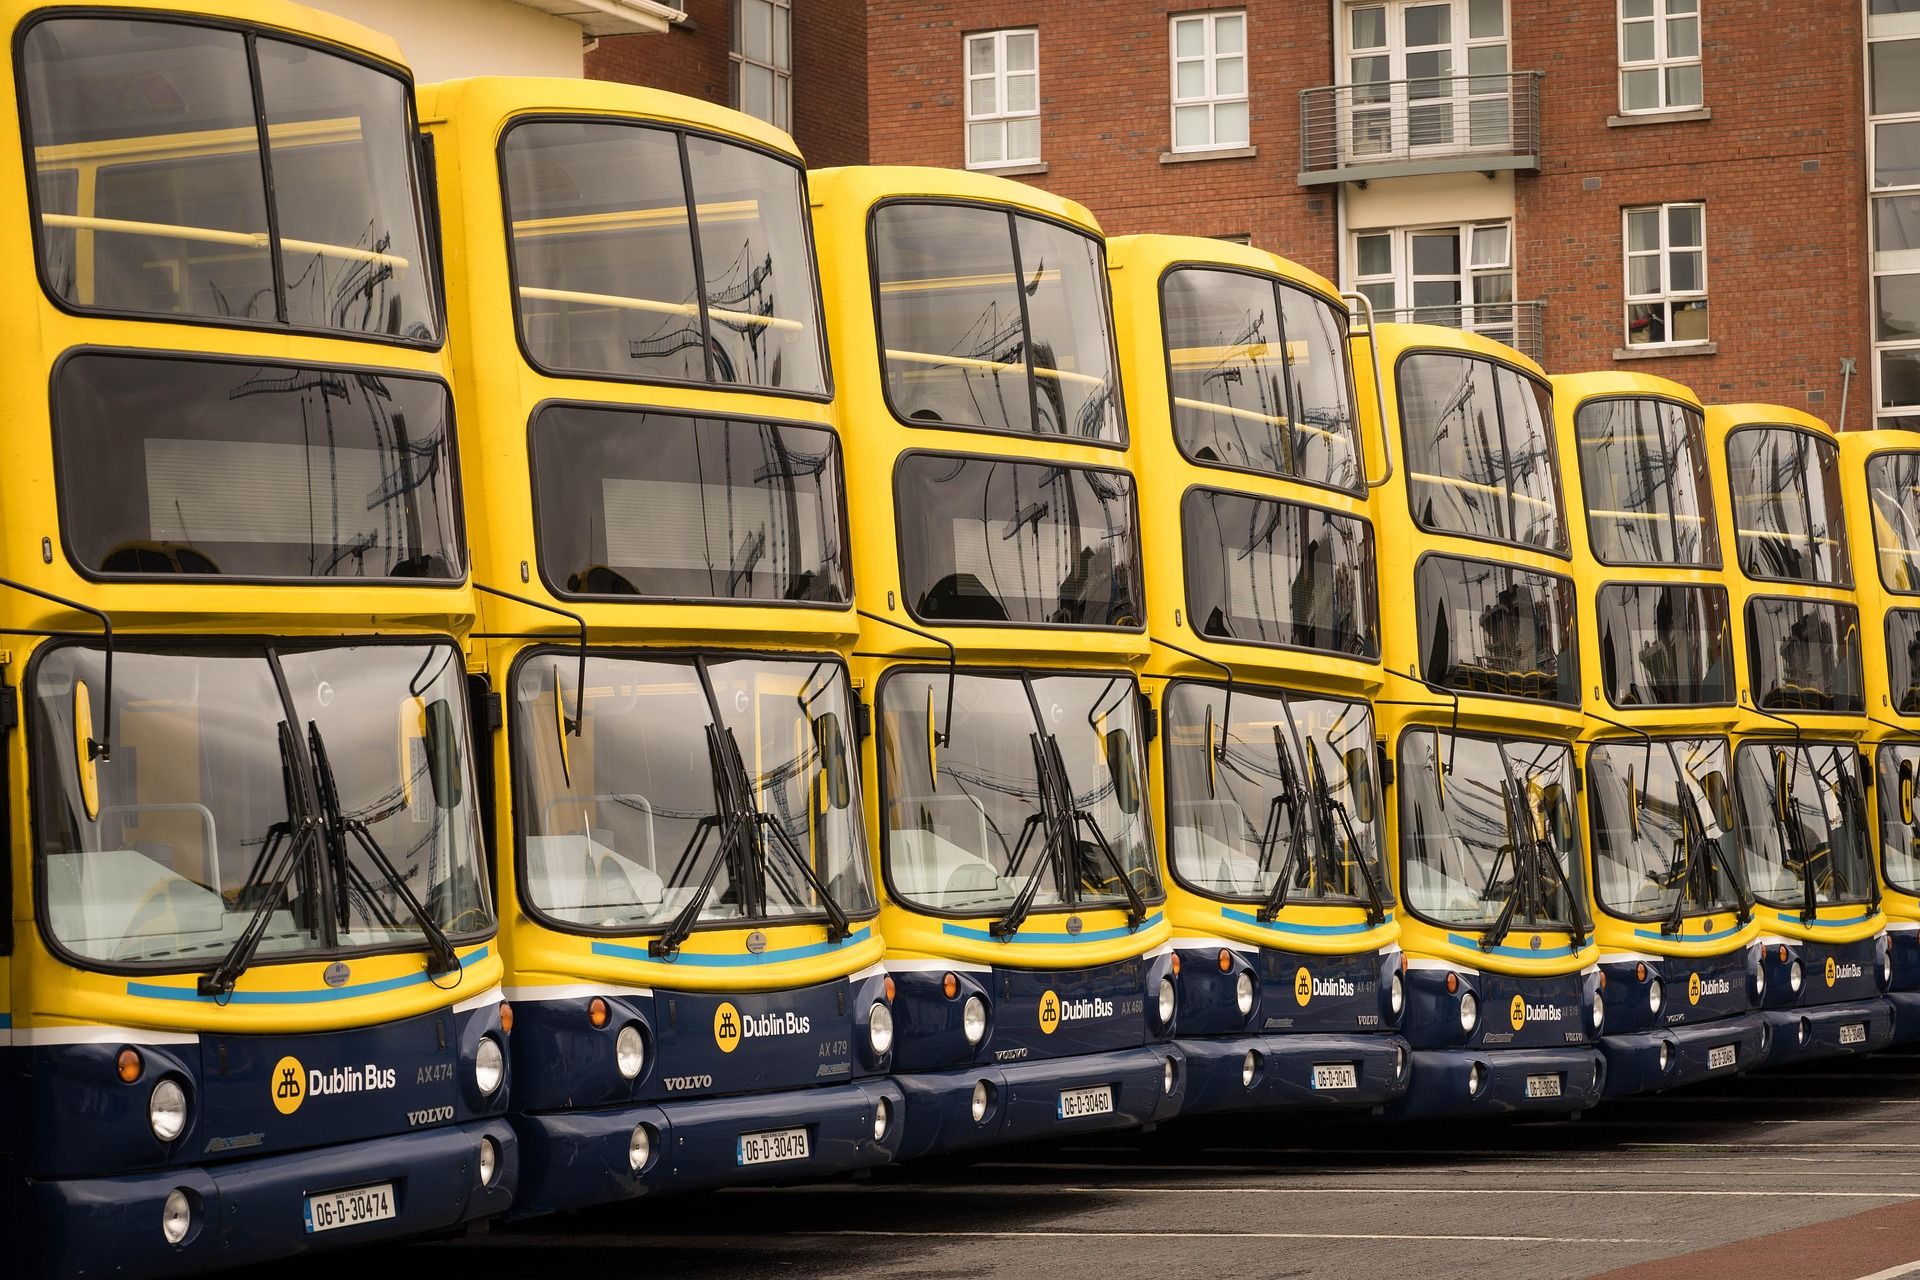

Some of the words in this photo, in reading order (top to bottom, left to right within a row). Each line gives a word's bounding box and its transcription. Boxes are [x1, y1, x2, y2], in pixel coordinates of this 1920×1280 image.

[1836, 964, 1851, 979] Dublin
[1851, 963, 1862, 977] Bus
[1313, 977, 1339, 996] Dublin
[1339, 978, 1354, 996] Bus
[1701, 979, 1719, 996] Dublin
[1719, 978, 1730, 994] Bus
[1061, 998, 1094, 1021] Dublin
[1094, 997, 1113, 1018] Bus
[1121, 1001, 1131, 1015] AX
[1526, 1004, 1549, 1021] Dublin
[1549, 1004, 1562, 1021] Bus
[743, 1013, 785, 1038] Dublin
[785, 1011, 810, 1035] Bus
[1357, 1015, 1379, 1025] VOLVO
[819, 1042, 831, 1057] AX
[832, 1040, 848, 1055] 479
[995, 1047, 1028, 1061] VOLVO
[309, 1065, 362, 1096] Dublin
[365, 1064, 396, 1091] Bus
[664, 1074, 712, 1091] VOLVO
[1064, 1093, 1109, 1115] 06-D-30460
[407, 1105, 455, 1126] VOLVO
[745, 1135, 805, 1161] 06-D-30479
[316, 1191, 388, 1227] 06-D-30474
